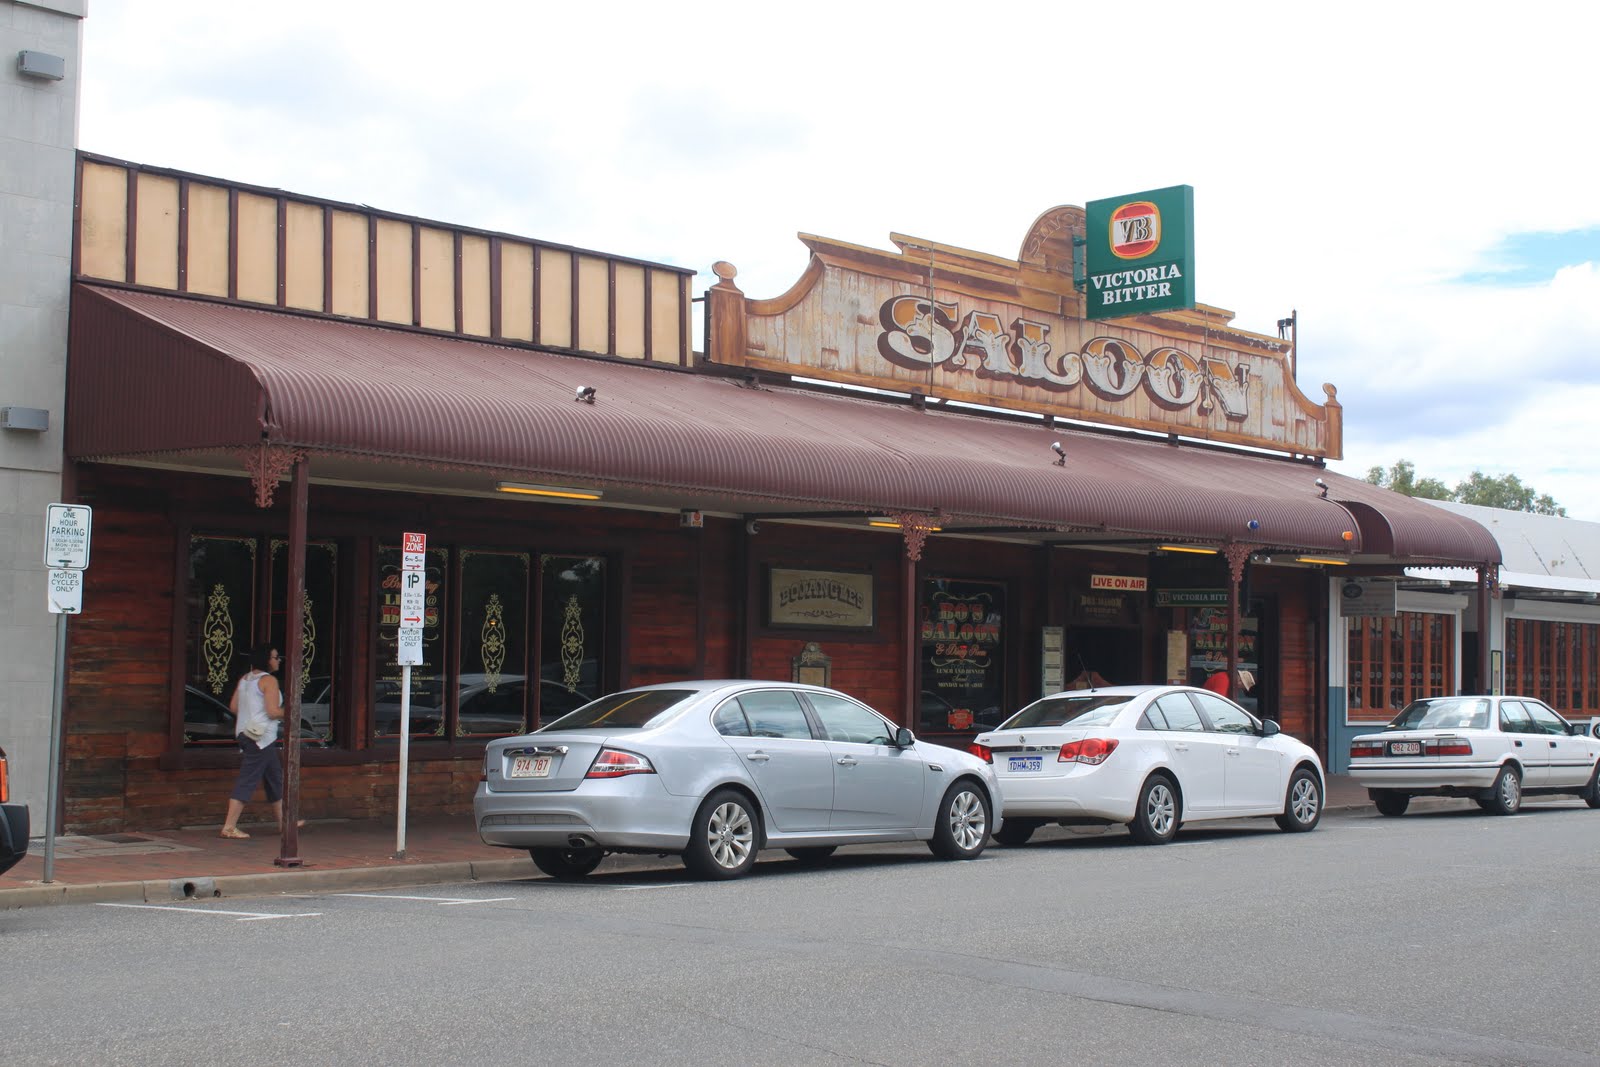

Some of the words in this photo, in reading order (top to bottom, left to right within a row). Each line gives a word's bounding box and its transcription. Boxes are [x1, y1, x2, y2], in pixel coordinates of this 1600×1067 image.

[1121, 217, 1152, 243] VB
[1091, 264, 1182, 290] VICTORIA
[1102, 283, 1171, 305] BITTER
[878, 295, 1250, 423] SALOON
[52, 526, 85, 537] PARKING
[410, 534, 421, 542] TAXI
[406, 542, 423, 551] ZONE
[407, 574, 420, 588] 1P
[1092, 577, 1113, 587] LIVE
[1114, 578, 1128, 588] ON
[1130, 580, 1145, 589] AIR
[780, 578, 865, 609] BOJANGLES
[1172, 593, 1209, 601] VICTORIA
[1210, 593, 1229, 601] BITT
[939, 602, 984, 622] BO'S
[921, 622, 1000, 643] SALOON
[516, 759, 530, 771] 974
[533, 759, 548, 771] 787
